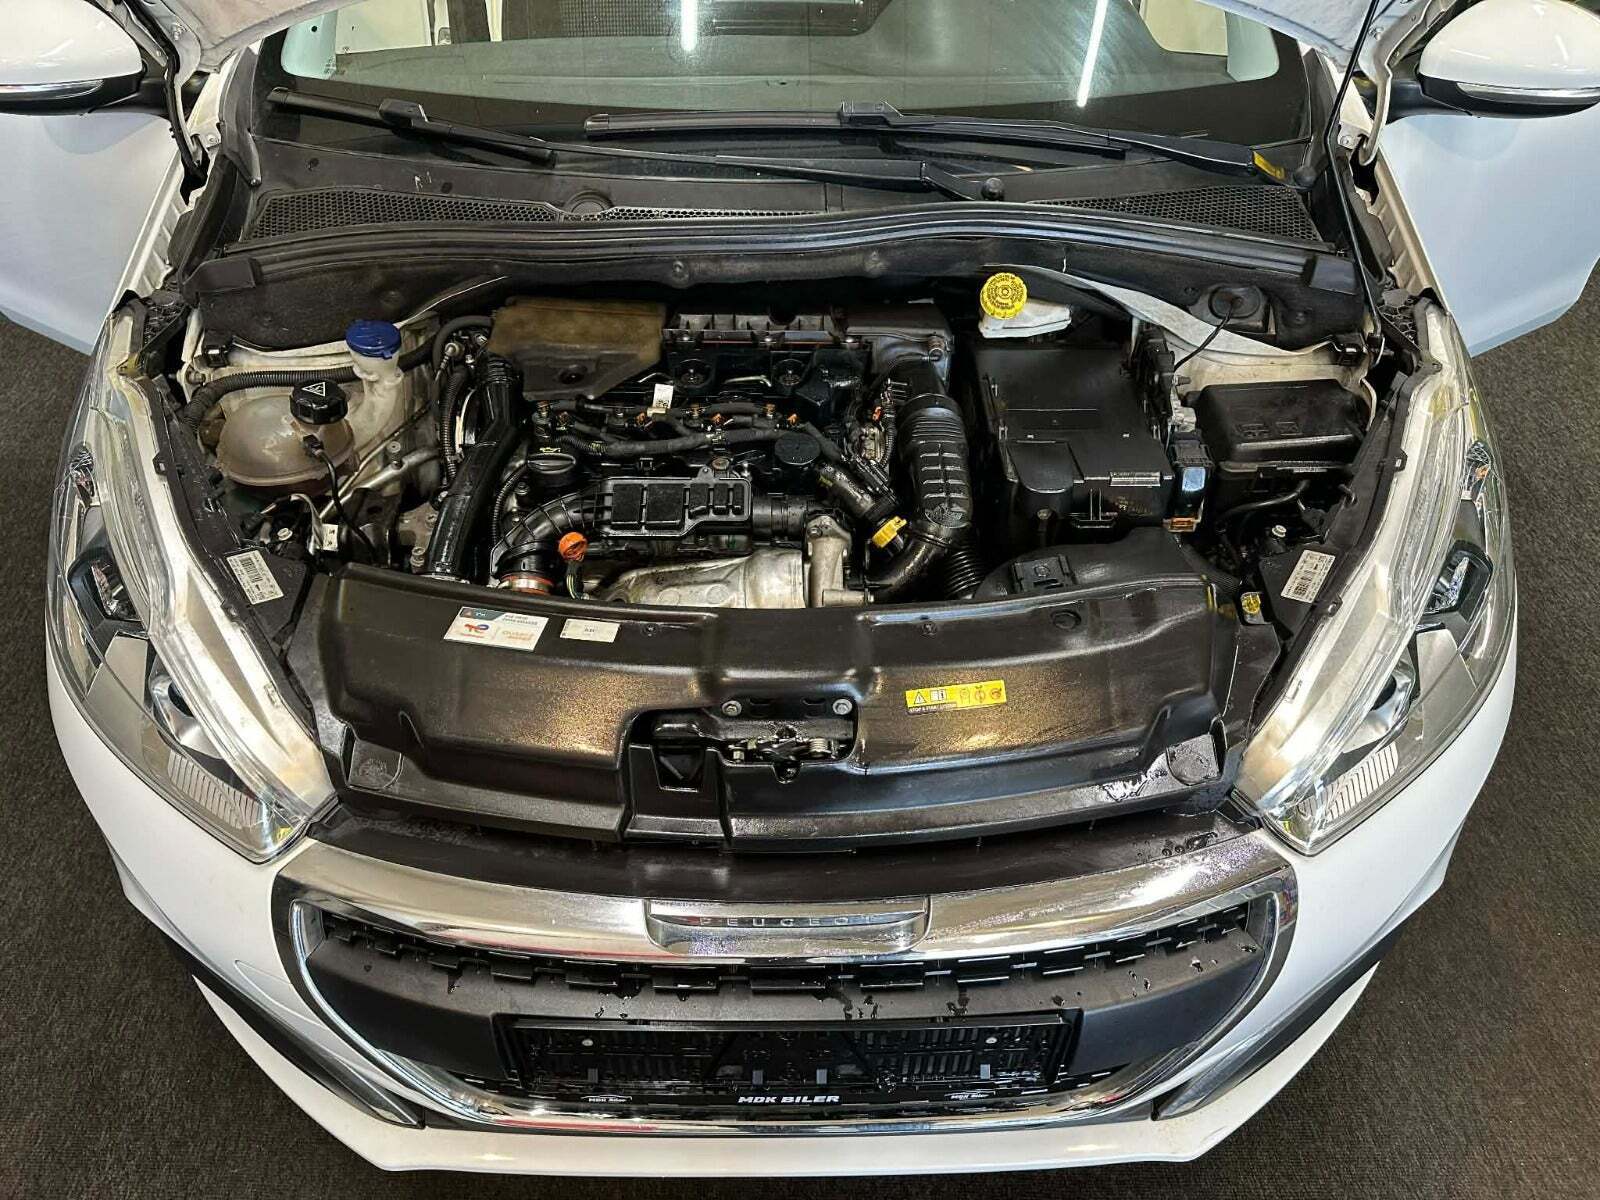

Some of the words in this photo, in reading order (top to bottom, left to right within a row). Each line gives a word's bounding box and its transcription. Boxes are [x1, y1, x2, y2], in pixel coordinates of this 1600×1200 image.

[699, 915, 877, 927] PEUGEOT
[738, 1096, 777, 1104] MDK
[780, 1095, 840, 1103] BILER
